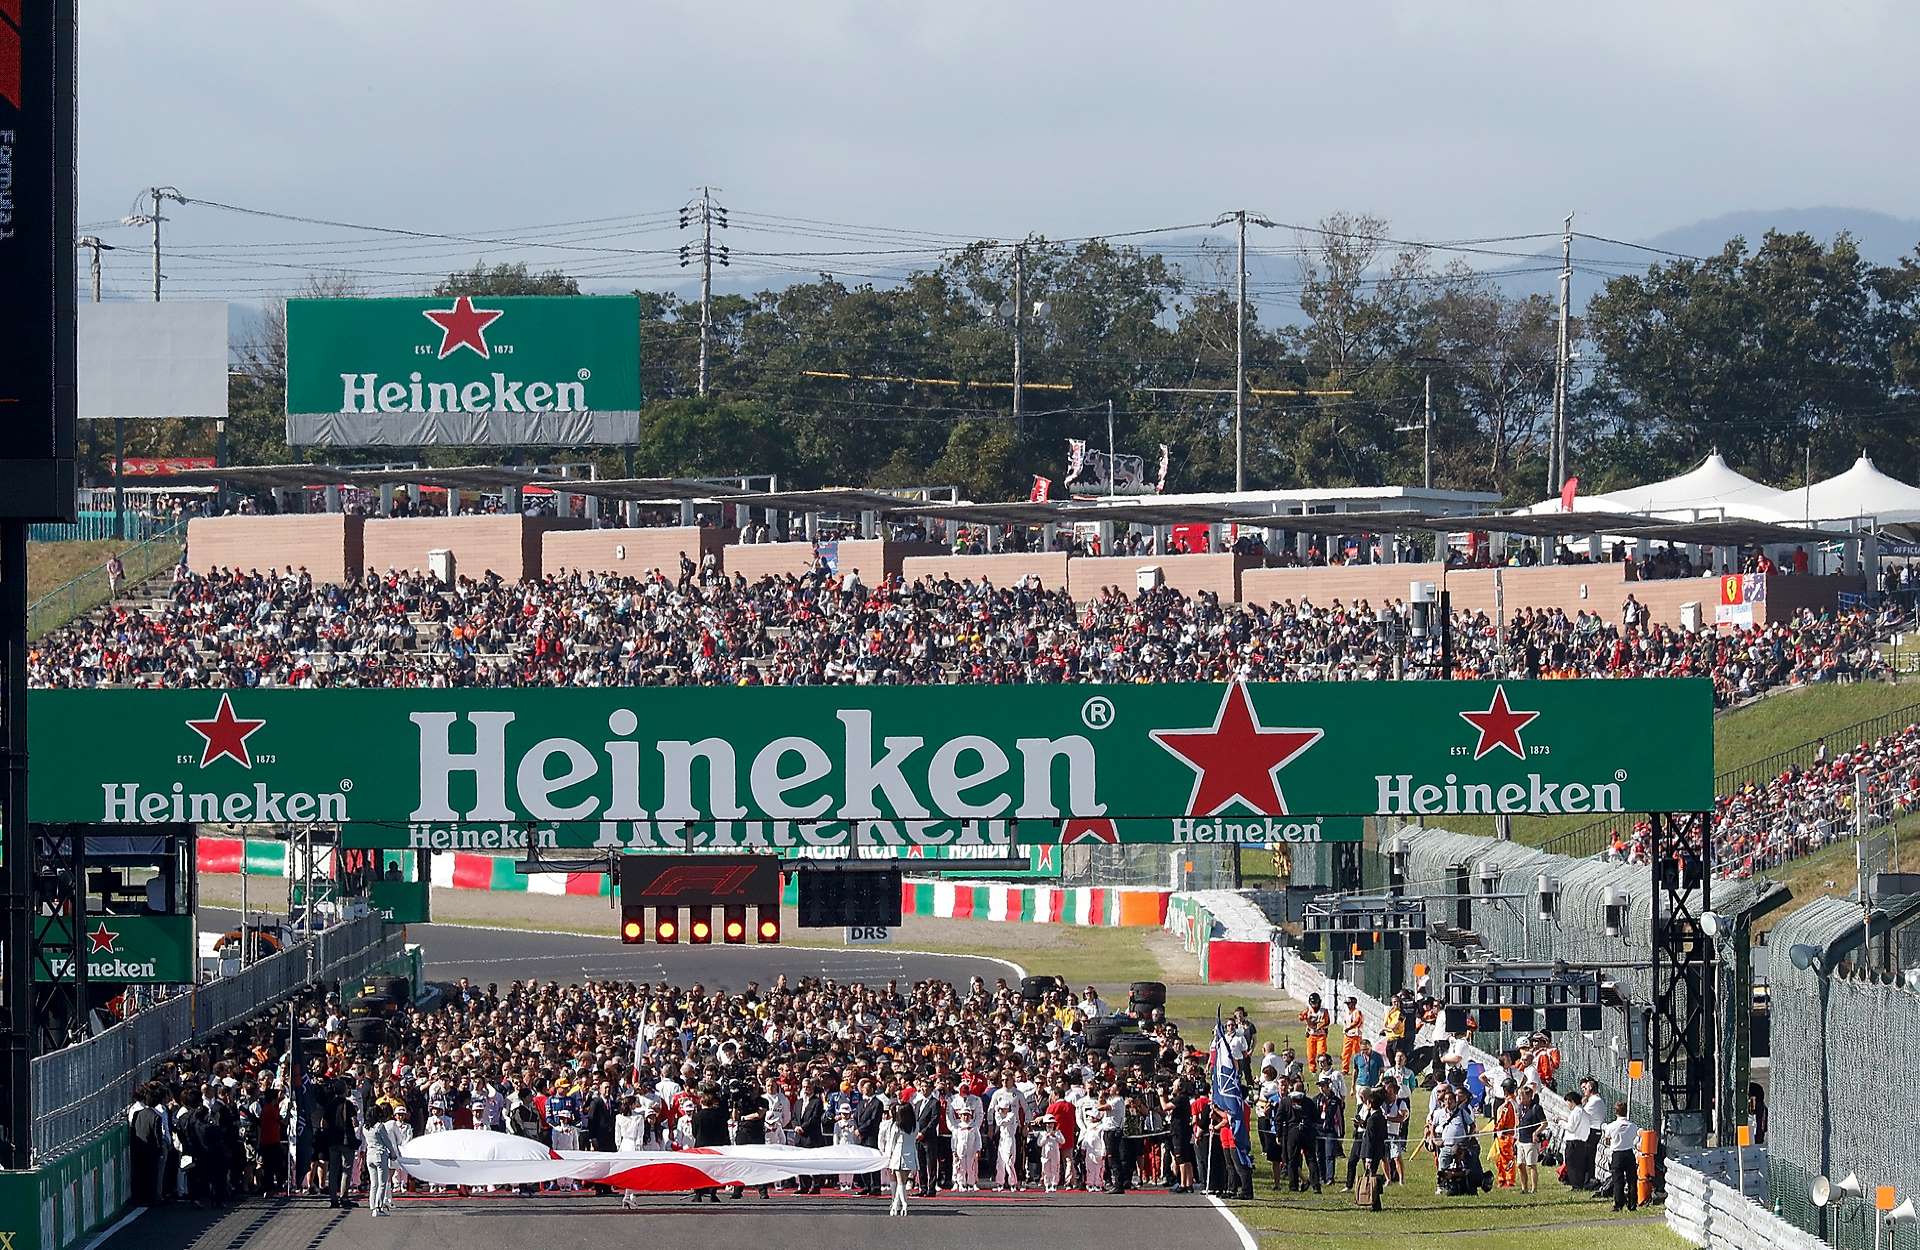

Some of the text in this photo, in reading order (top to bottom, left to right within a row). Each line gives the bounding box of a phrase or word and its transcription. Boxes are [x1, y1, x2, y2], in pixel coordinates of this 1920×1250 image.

[415, 345, 514, 354] EST. 1873
[1450, 745, 1550, 755] EST. 1873
[177, 755, 276, 764] EST. 1873
[851, 926, 888, 940] DRS
[50, 959, 155, 977] Heneken
